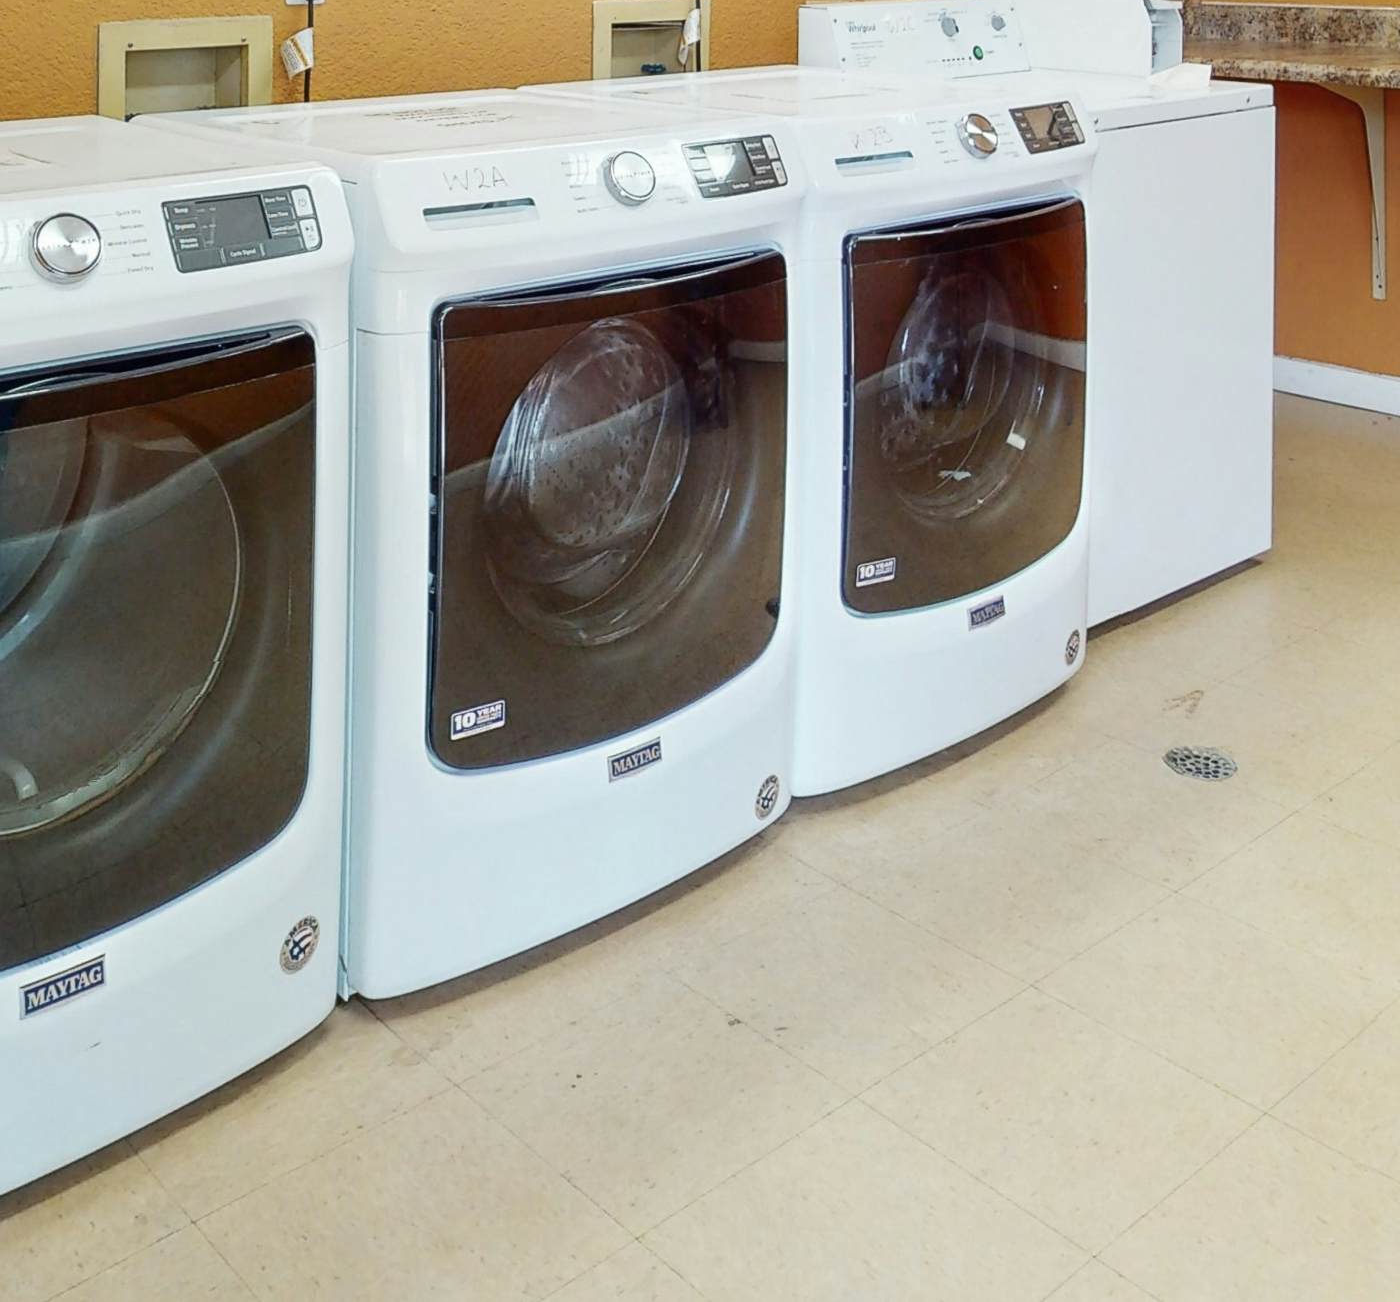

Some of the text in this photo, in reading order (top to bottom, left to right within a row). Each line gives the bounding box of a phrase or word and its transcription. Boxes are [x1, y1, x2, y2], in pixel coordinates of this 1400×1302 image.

[442, 166, 509, 191] W2A
[859, 564, 875, 579] 10
[454, 711, 477, 731] 10
[613, 746, 660, 776] MAYTAG
[26, 964, 103, 1011] MAYTAG
